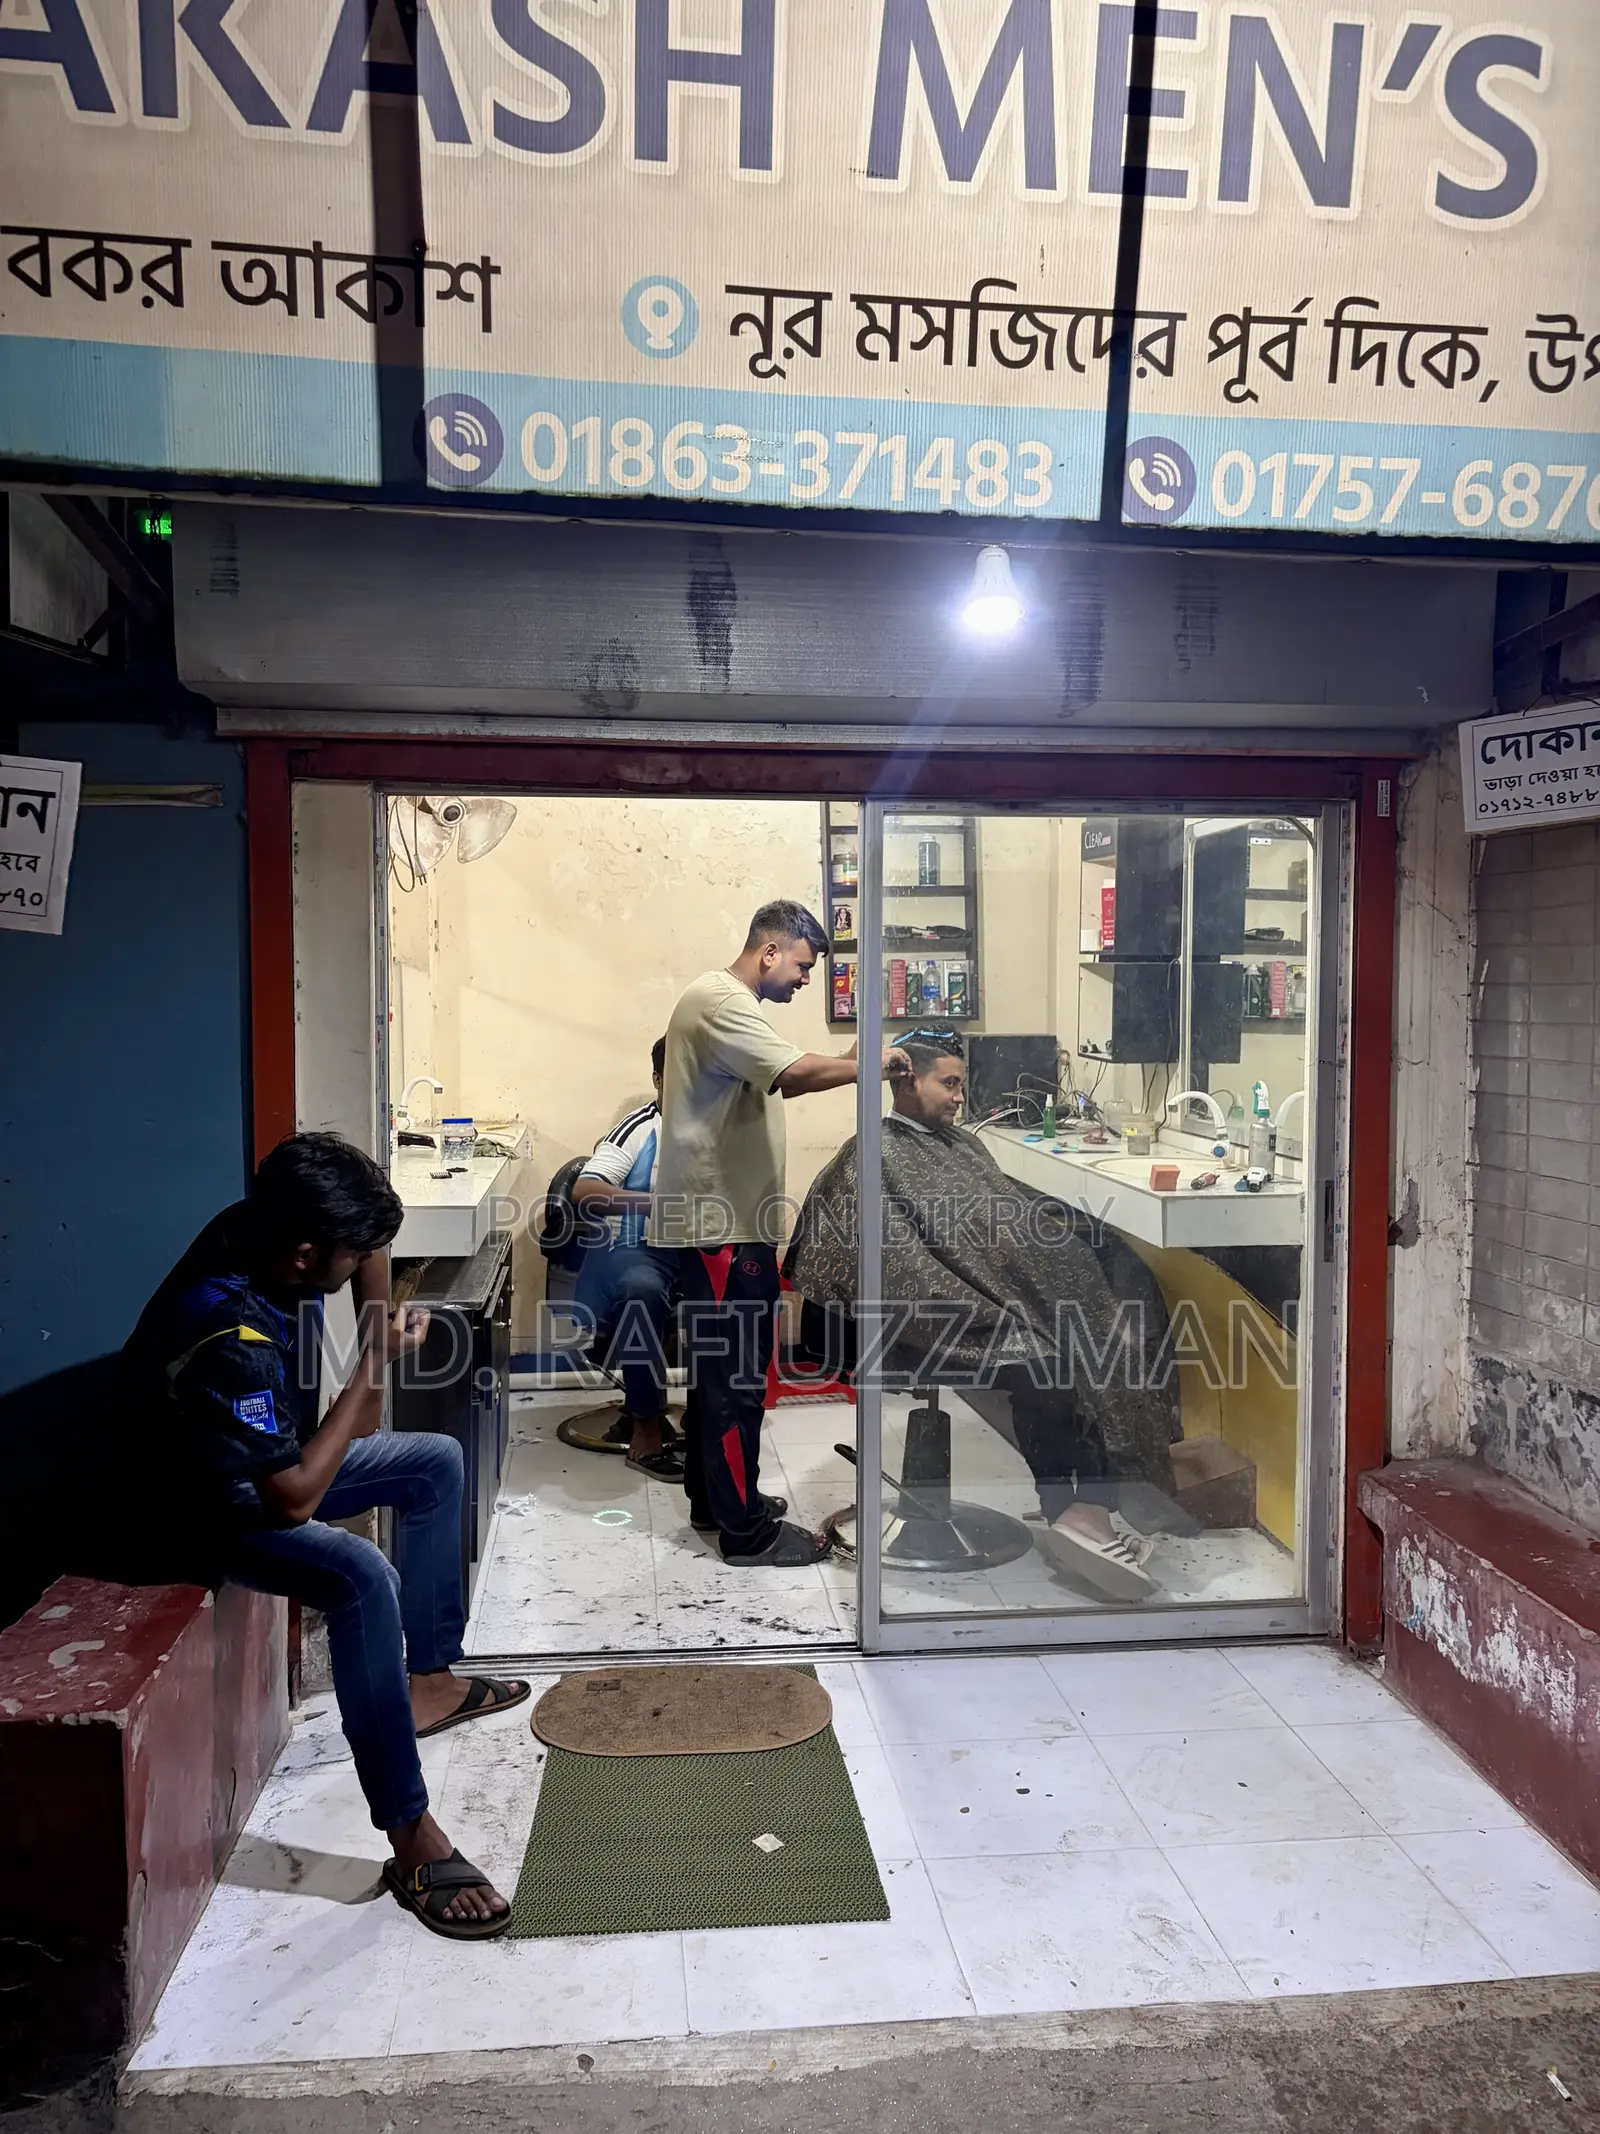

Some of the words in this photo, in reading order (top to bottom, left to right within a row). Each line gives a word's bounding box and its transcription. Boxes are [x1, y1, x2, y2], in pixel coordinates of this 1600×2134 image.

[866, 0, 1543, 221] MEN'S
[0, 226, 191, 309] বকর
[211, 240, 501, 333] আকাশ
[725, 284, 831, 379] নূর
[850, 277, 1186, 379] মসজিদের
[1207, 296, 1315, 403] পূর্ব
[1324, 296, 1500, 403] দিকে,
[520, 410, 1054, 508] 01863-371483
[1479, 788, 1599, 813] ০১৭১২-৭৪৮৮
[1483, 774, 1523, 791] ভাড়া
[1528, 767, 1579, 786] দেওয়া
[0, 786, 57, 834] ান
[1085, 831, 1103, 849] CLEAR
[240, 1403, 267, 1415] UNITES
